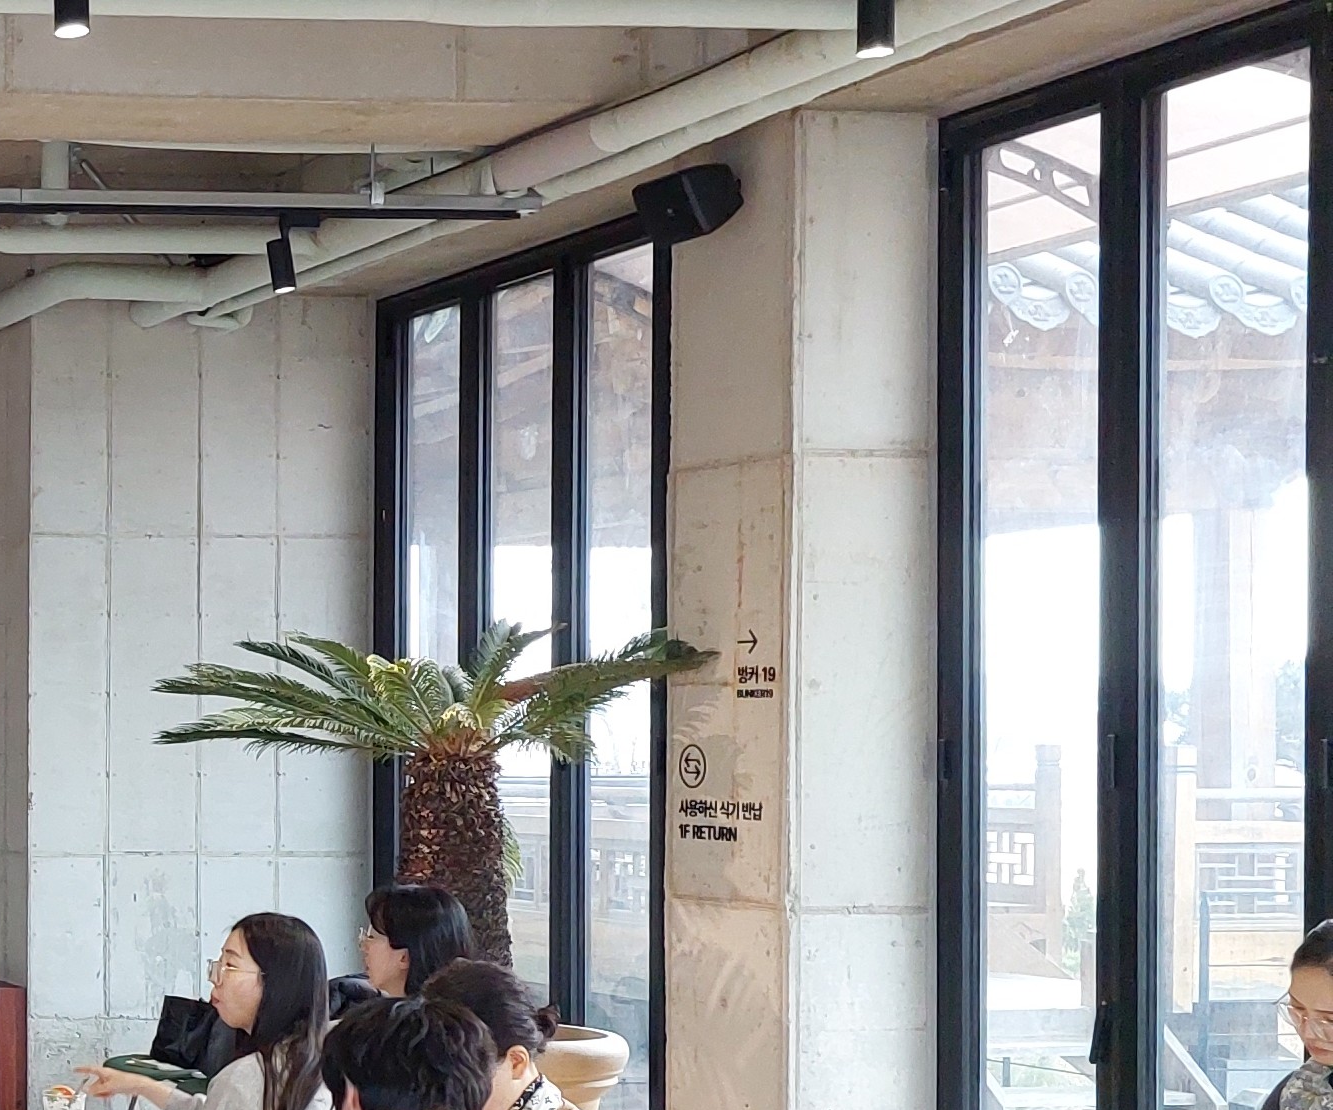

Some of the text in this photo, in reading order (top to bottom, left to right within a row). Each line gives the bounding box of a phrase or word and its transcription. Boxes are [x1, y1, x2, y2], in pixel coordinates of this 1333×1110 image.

[737, 665, 776, 684] 벙커 19
[678, 798, 763, 821] 사용하신 식기 반납
[678, 823, 738, 842] 1F RETURN
